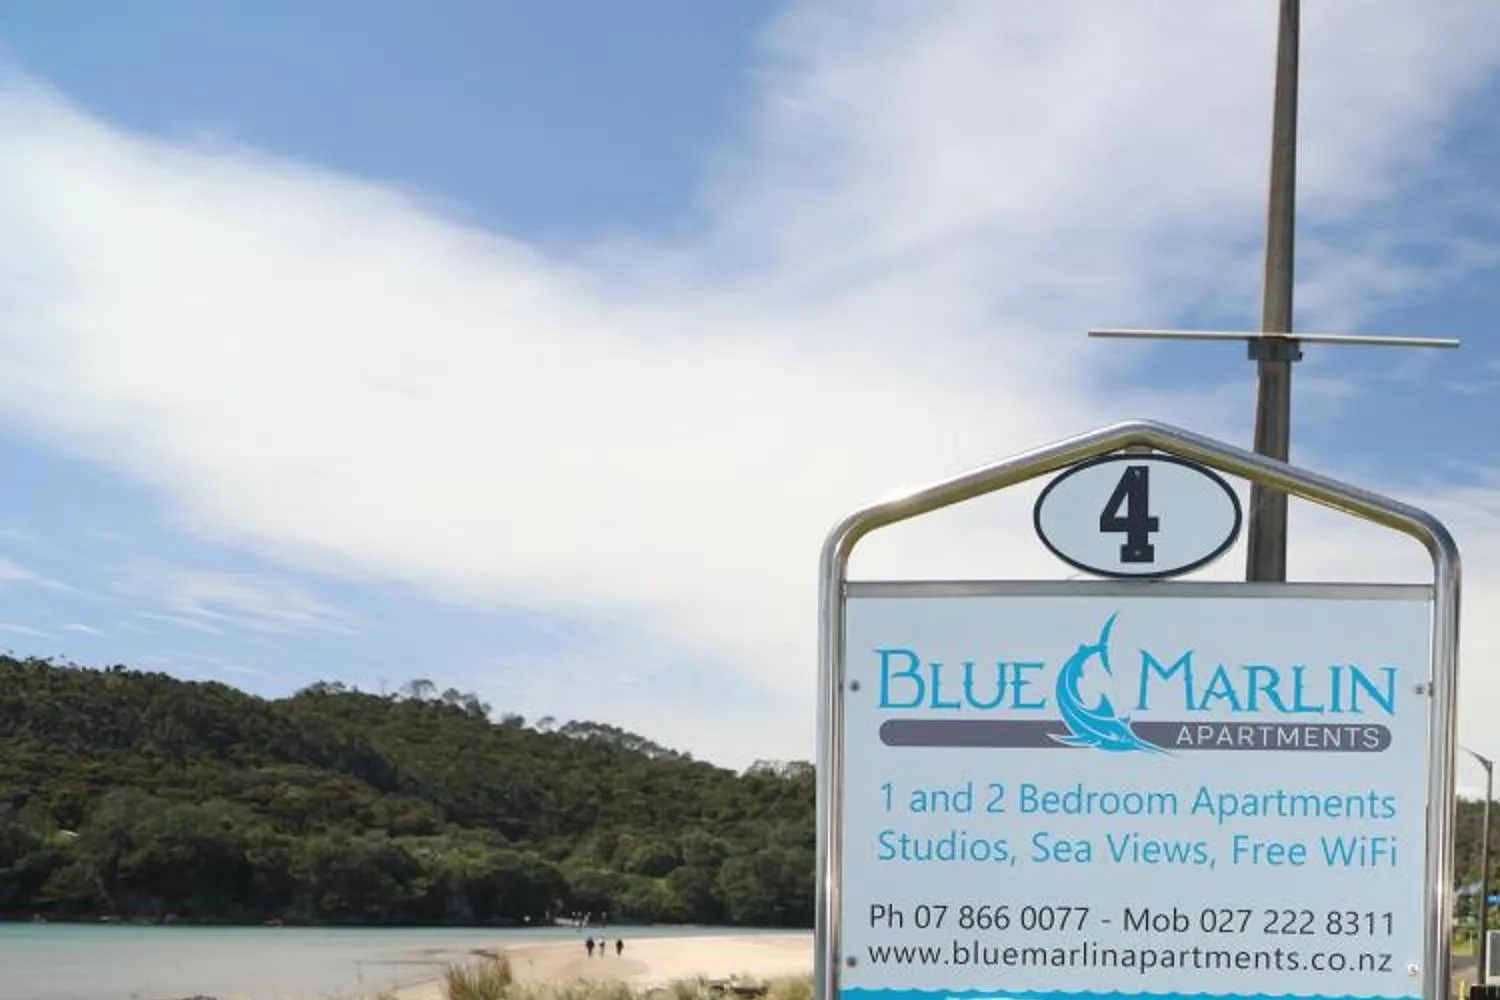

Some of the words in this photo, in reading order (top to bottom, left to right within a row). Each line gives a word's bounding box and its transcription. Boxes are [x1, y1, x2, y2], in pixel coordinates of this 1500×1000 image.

[1099, 465, 1160, 564] 4
[873, 648, 1047, 710] BLUE
[1135, 648, 1399, 716] MARLIN
[1176, 725, 1381, 749] APARTMENTS
[880, 783, 894, 812] 1
[909, 782, 974, 813] and
[986, 783, 1006, 814] 2
[1020, 784, 1178, 817] Bedroom
[1191, 786, 1396, 824] Apartments
[878, 829, 1017, 867] Studios,
[1031, 831, 1092, 863] Sea
[1106, 831, 1217, 870] Views,
[1233, 834, 1308, 866] Free
[1321, 836, 1398, 867] WiFi
[869, 904, 904, 929] Ph
[914, 905, 949, 930] 07
[958, 905, 1011, 931] 866
[1020, 906, 1090, 932] 0077
[1123, 907, 1190, 933] Mob
[1200, 908, 1253, 934] 027
[1263, 910, 1316, 936] 222
[1325, 911, 1394, 937] 8311
[867, 939, 1393, 975] www.bluemarlinapartments.co.nz
